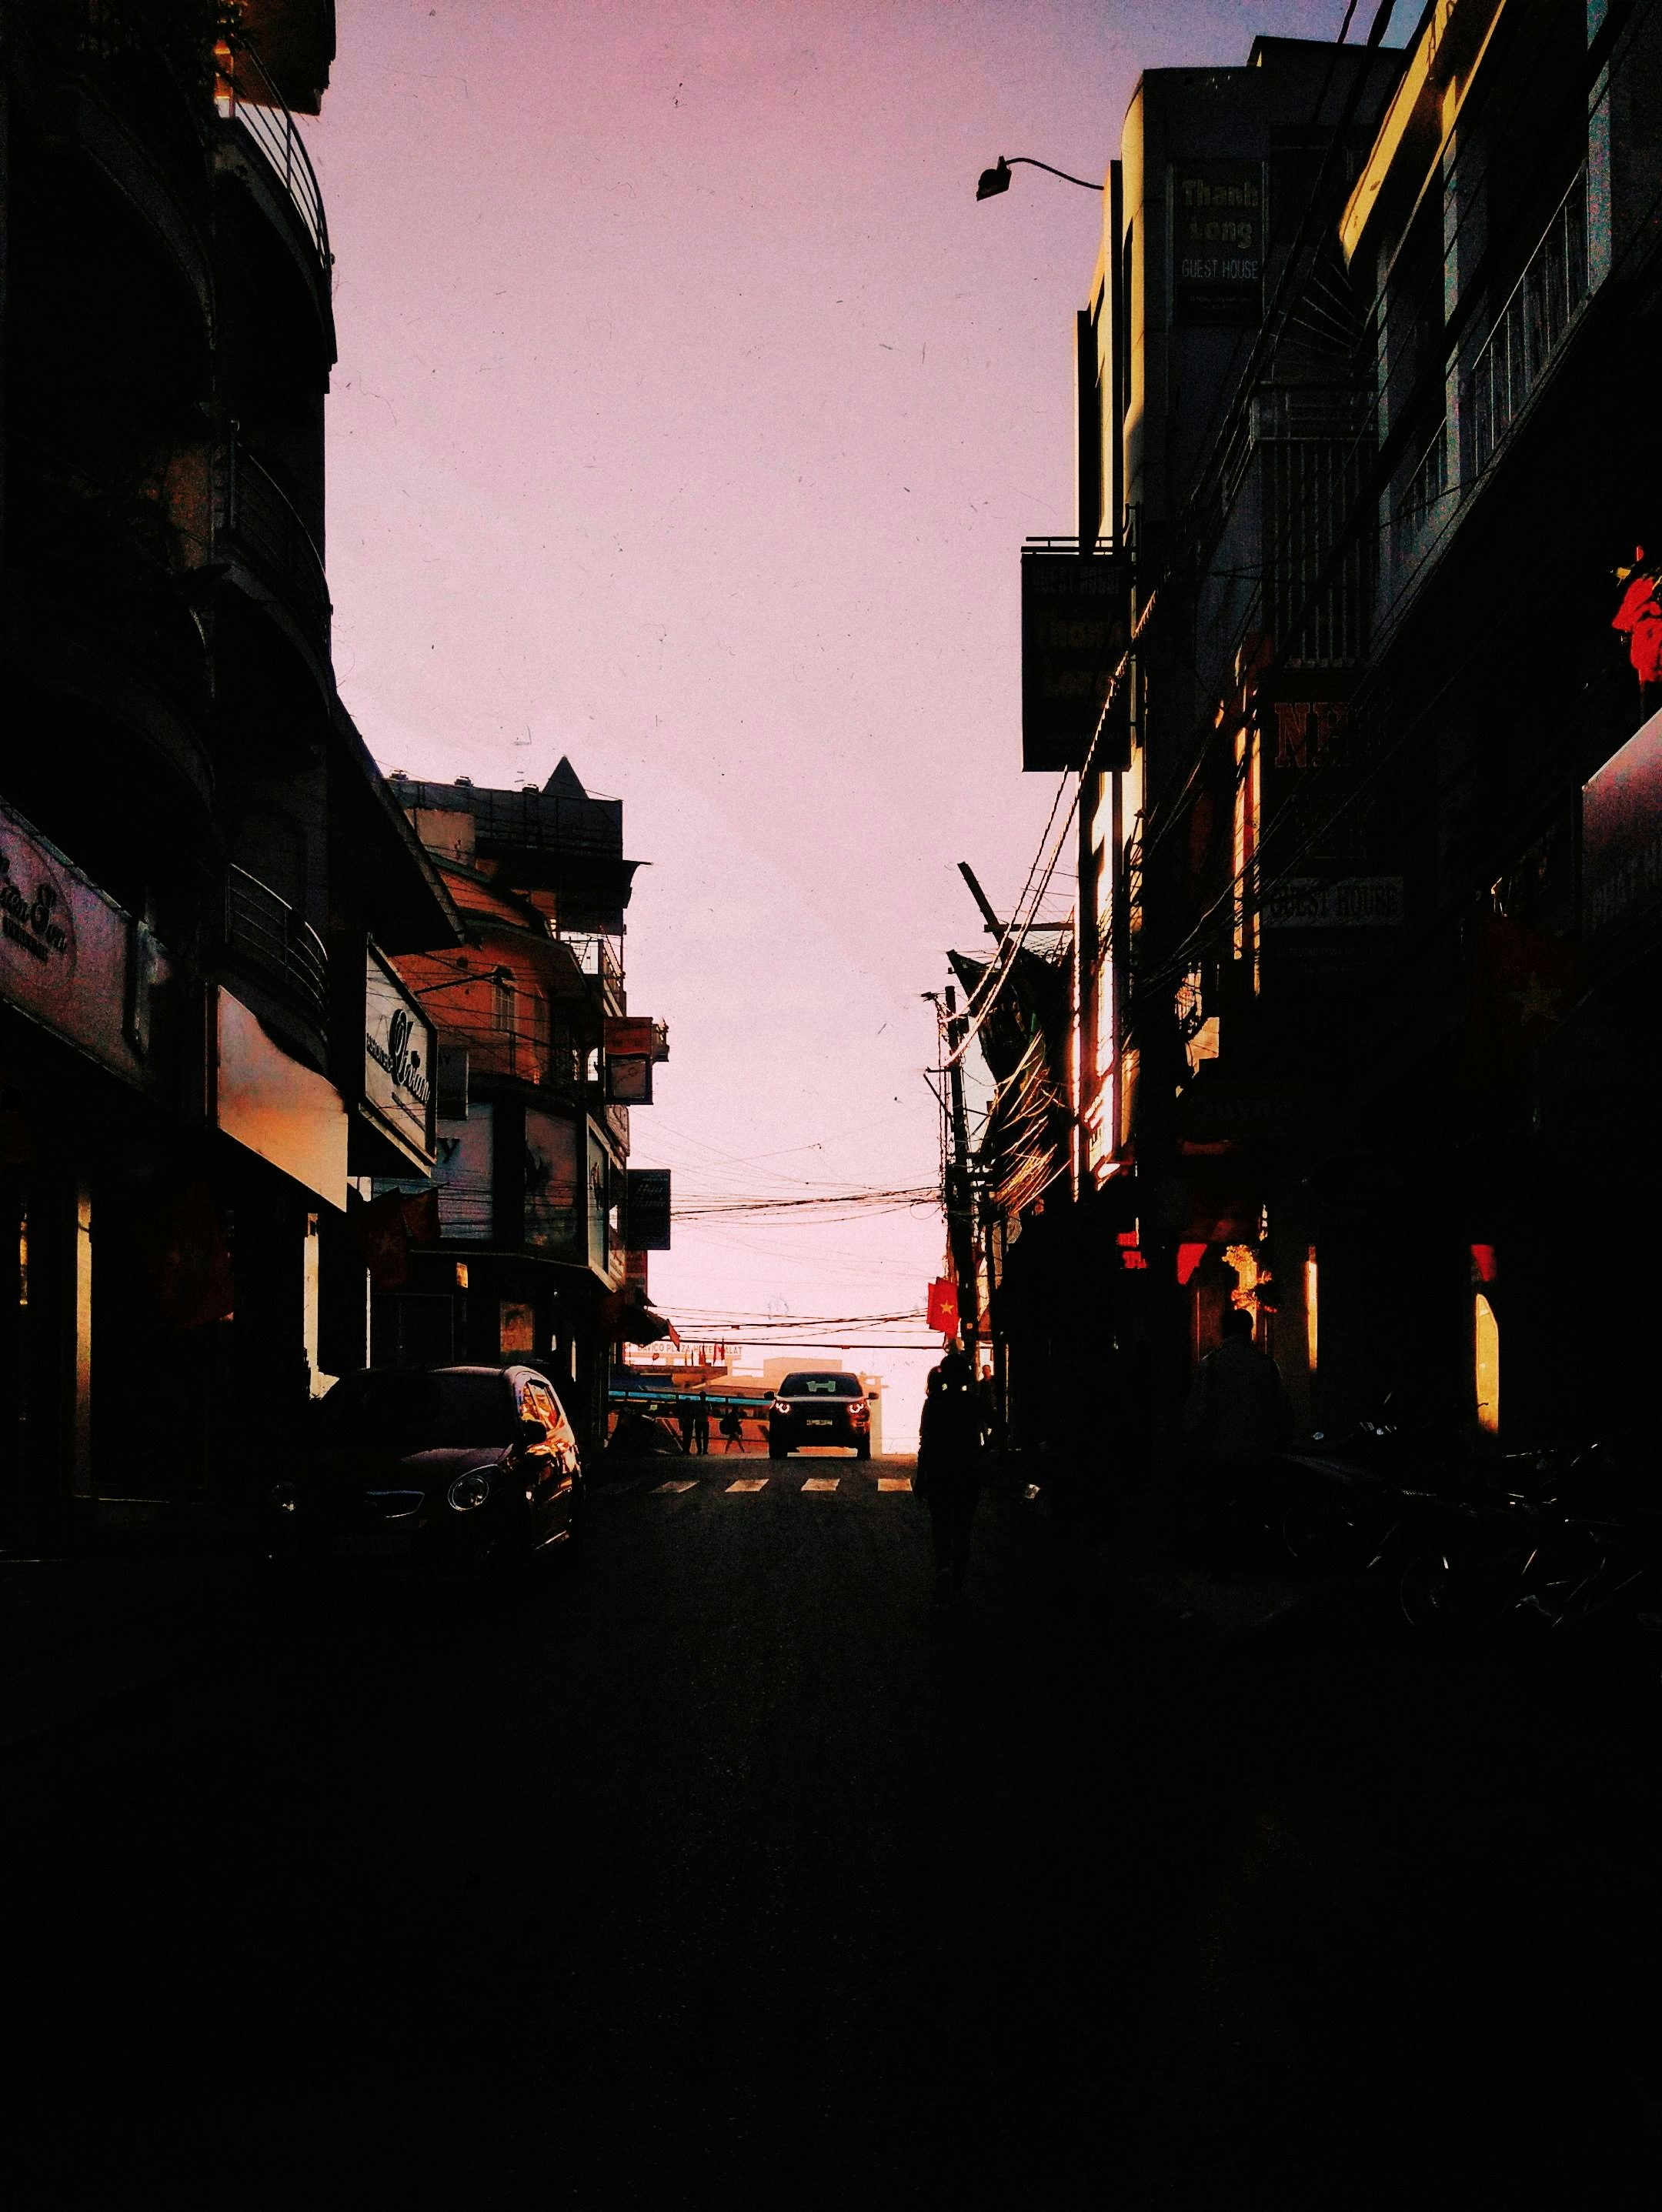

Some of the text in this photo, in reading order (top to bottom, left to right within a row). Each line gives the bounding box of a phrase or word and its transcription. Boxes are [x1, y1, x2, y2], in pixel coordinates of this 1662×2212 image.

[1182, 179, 1258, 206] Thanh
[1182, 259, 1258, 279] GUEST HOUSE
[666, 1343, 690, 1353] PLZA
